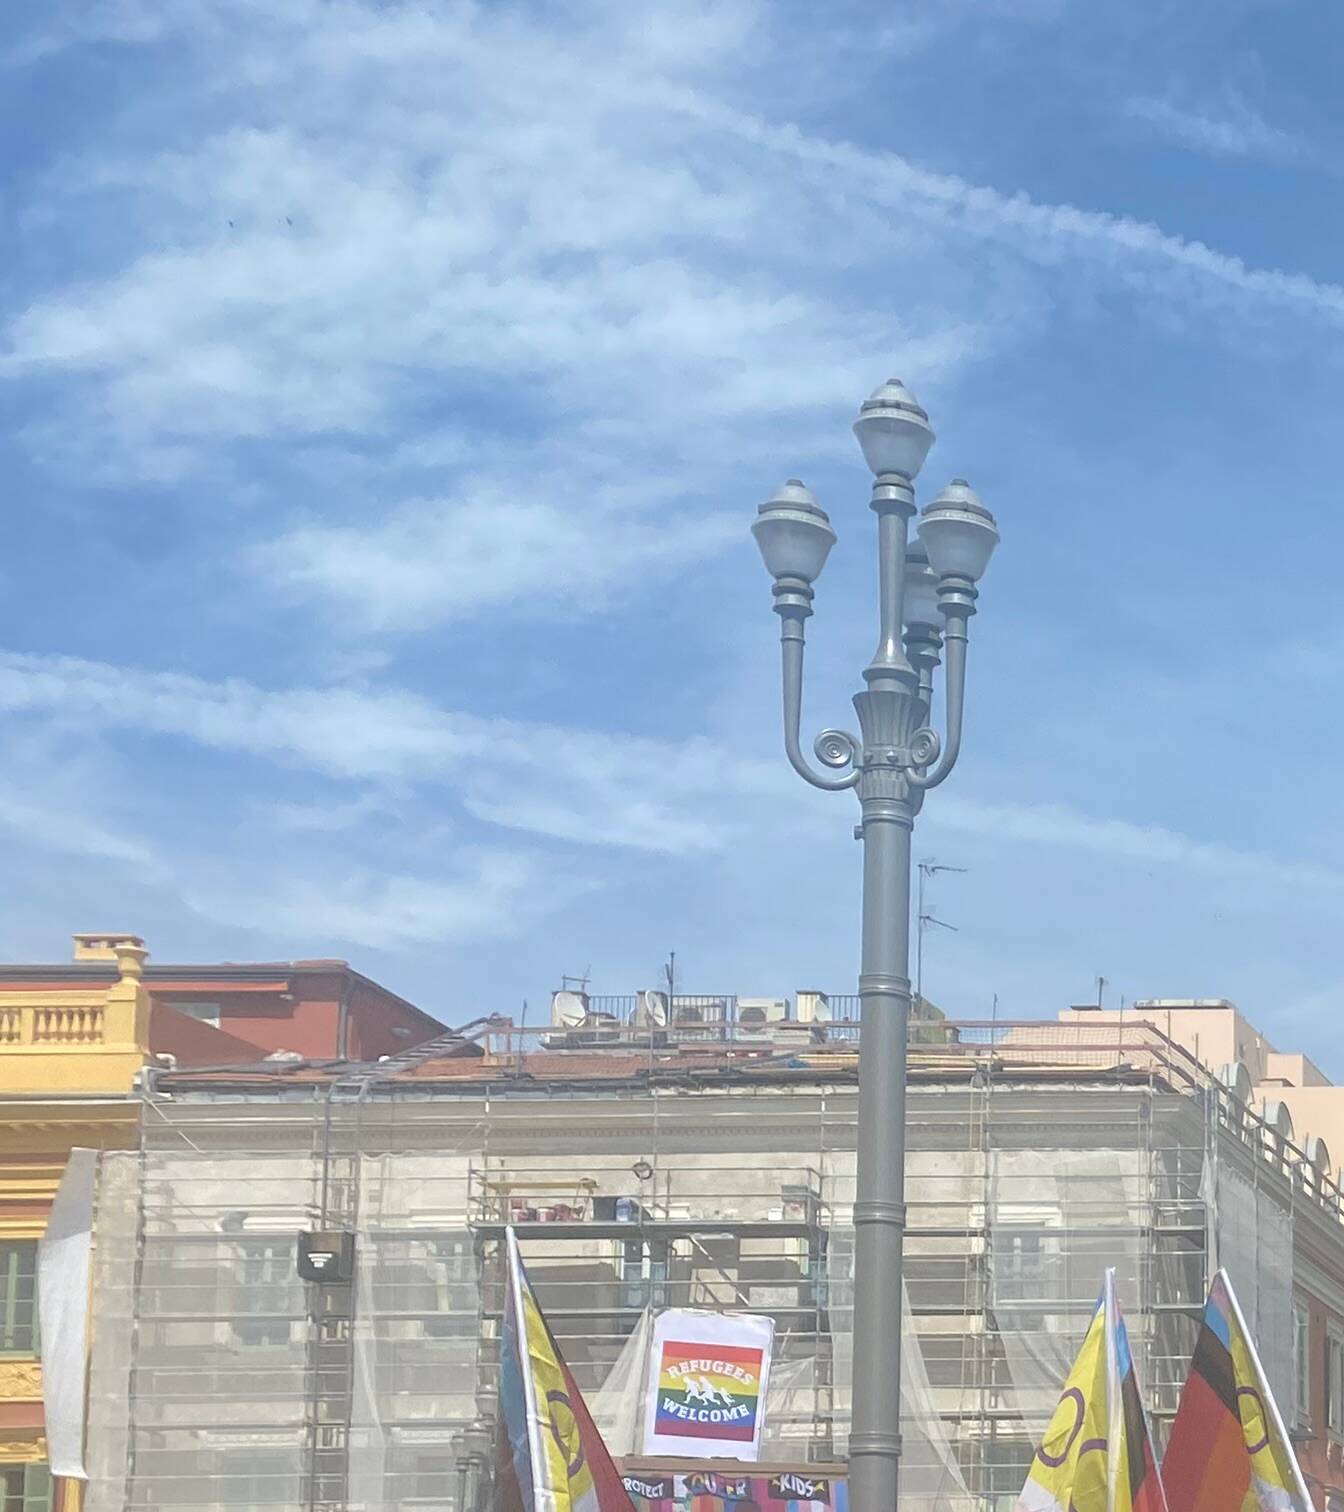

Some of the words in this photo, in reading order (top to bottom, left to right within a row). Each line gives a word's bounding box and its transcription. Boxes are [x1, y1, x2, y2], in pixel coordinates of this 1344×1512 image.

[666, 1359, 754, 1385] REFUGEES
[662, 1397, 750, 1422] WELCOME
[623, 1475, 665, 1498] ROTECT
[780, 1473, 814, 1497] KIDS
